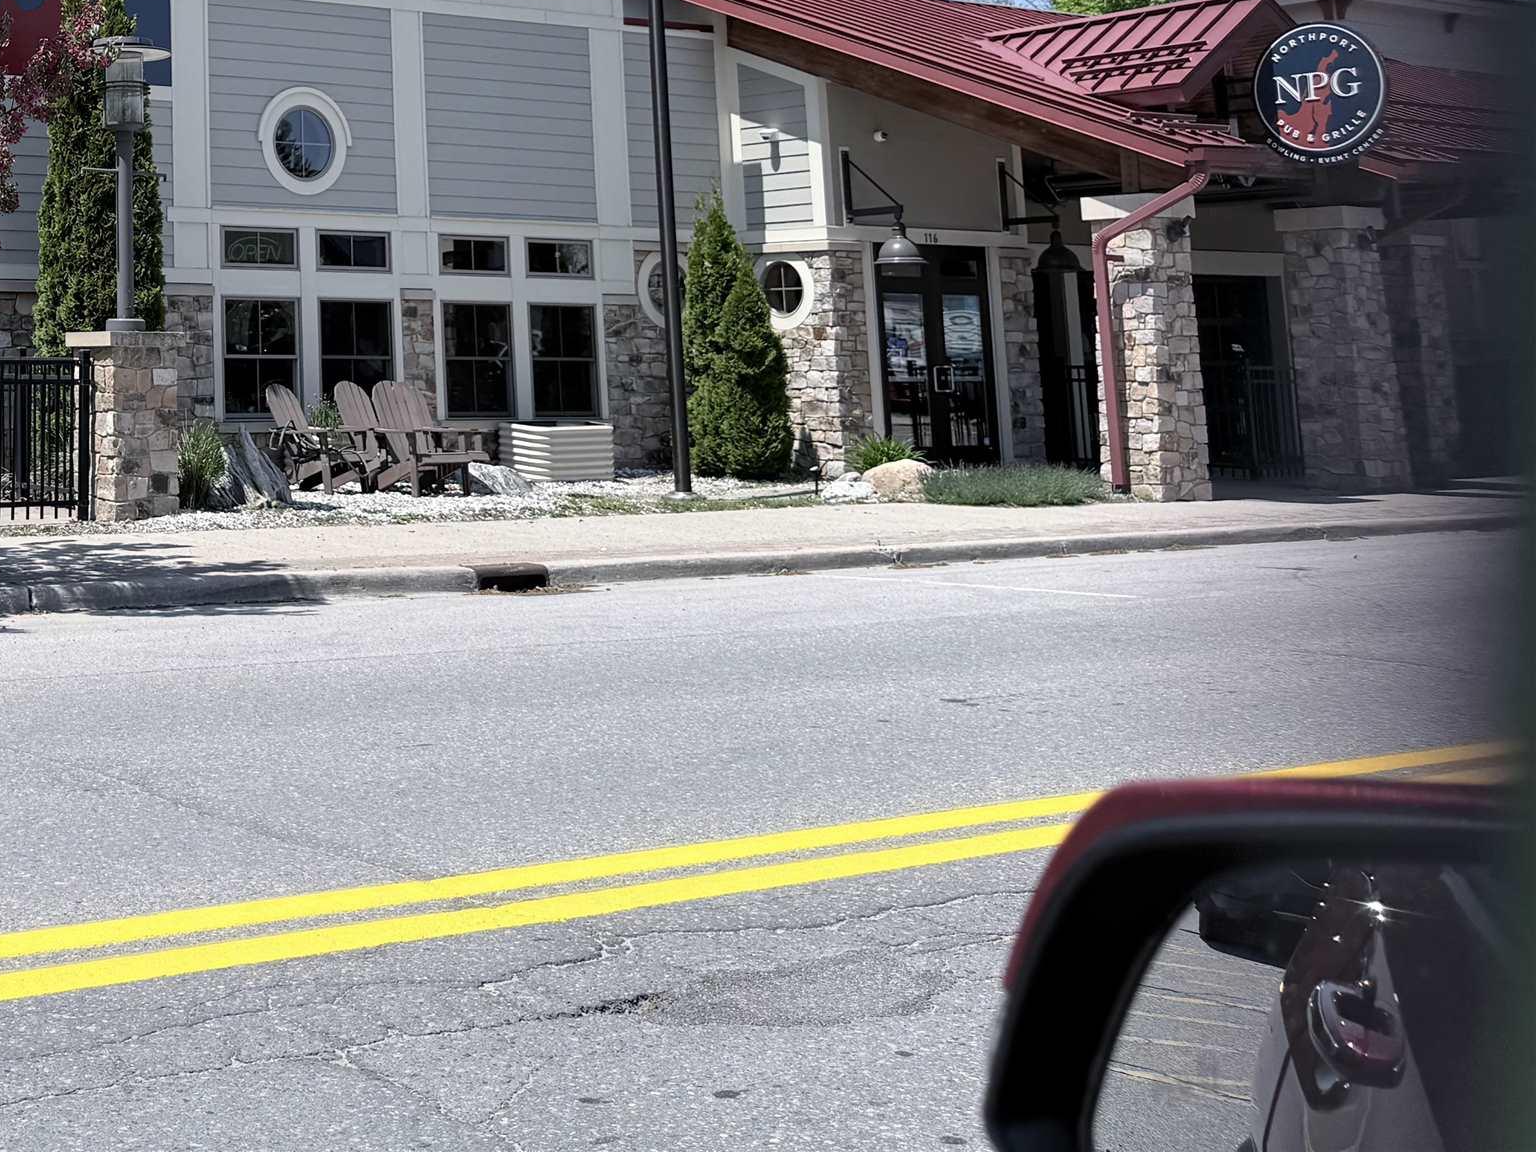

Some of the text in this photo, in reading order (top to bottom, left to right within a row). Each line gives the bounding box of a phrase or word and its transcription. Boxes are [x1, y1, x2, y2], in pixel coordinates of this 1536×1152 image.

[1271, 32, 1358, 63] NORTHPORT
[1272, 67, 1362, 104] NPG
[1276, 109, 1367, 143] PUB & GRILLE
[1266, 128, 1384, 164] BOWLING EVENT CENTER
[229, 243, 282, 261] OPEN
[924, 232, 938, 243] 116
